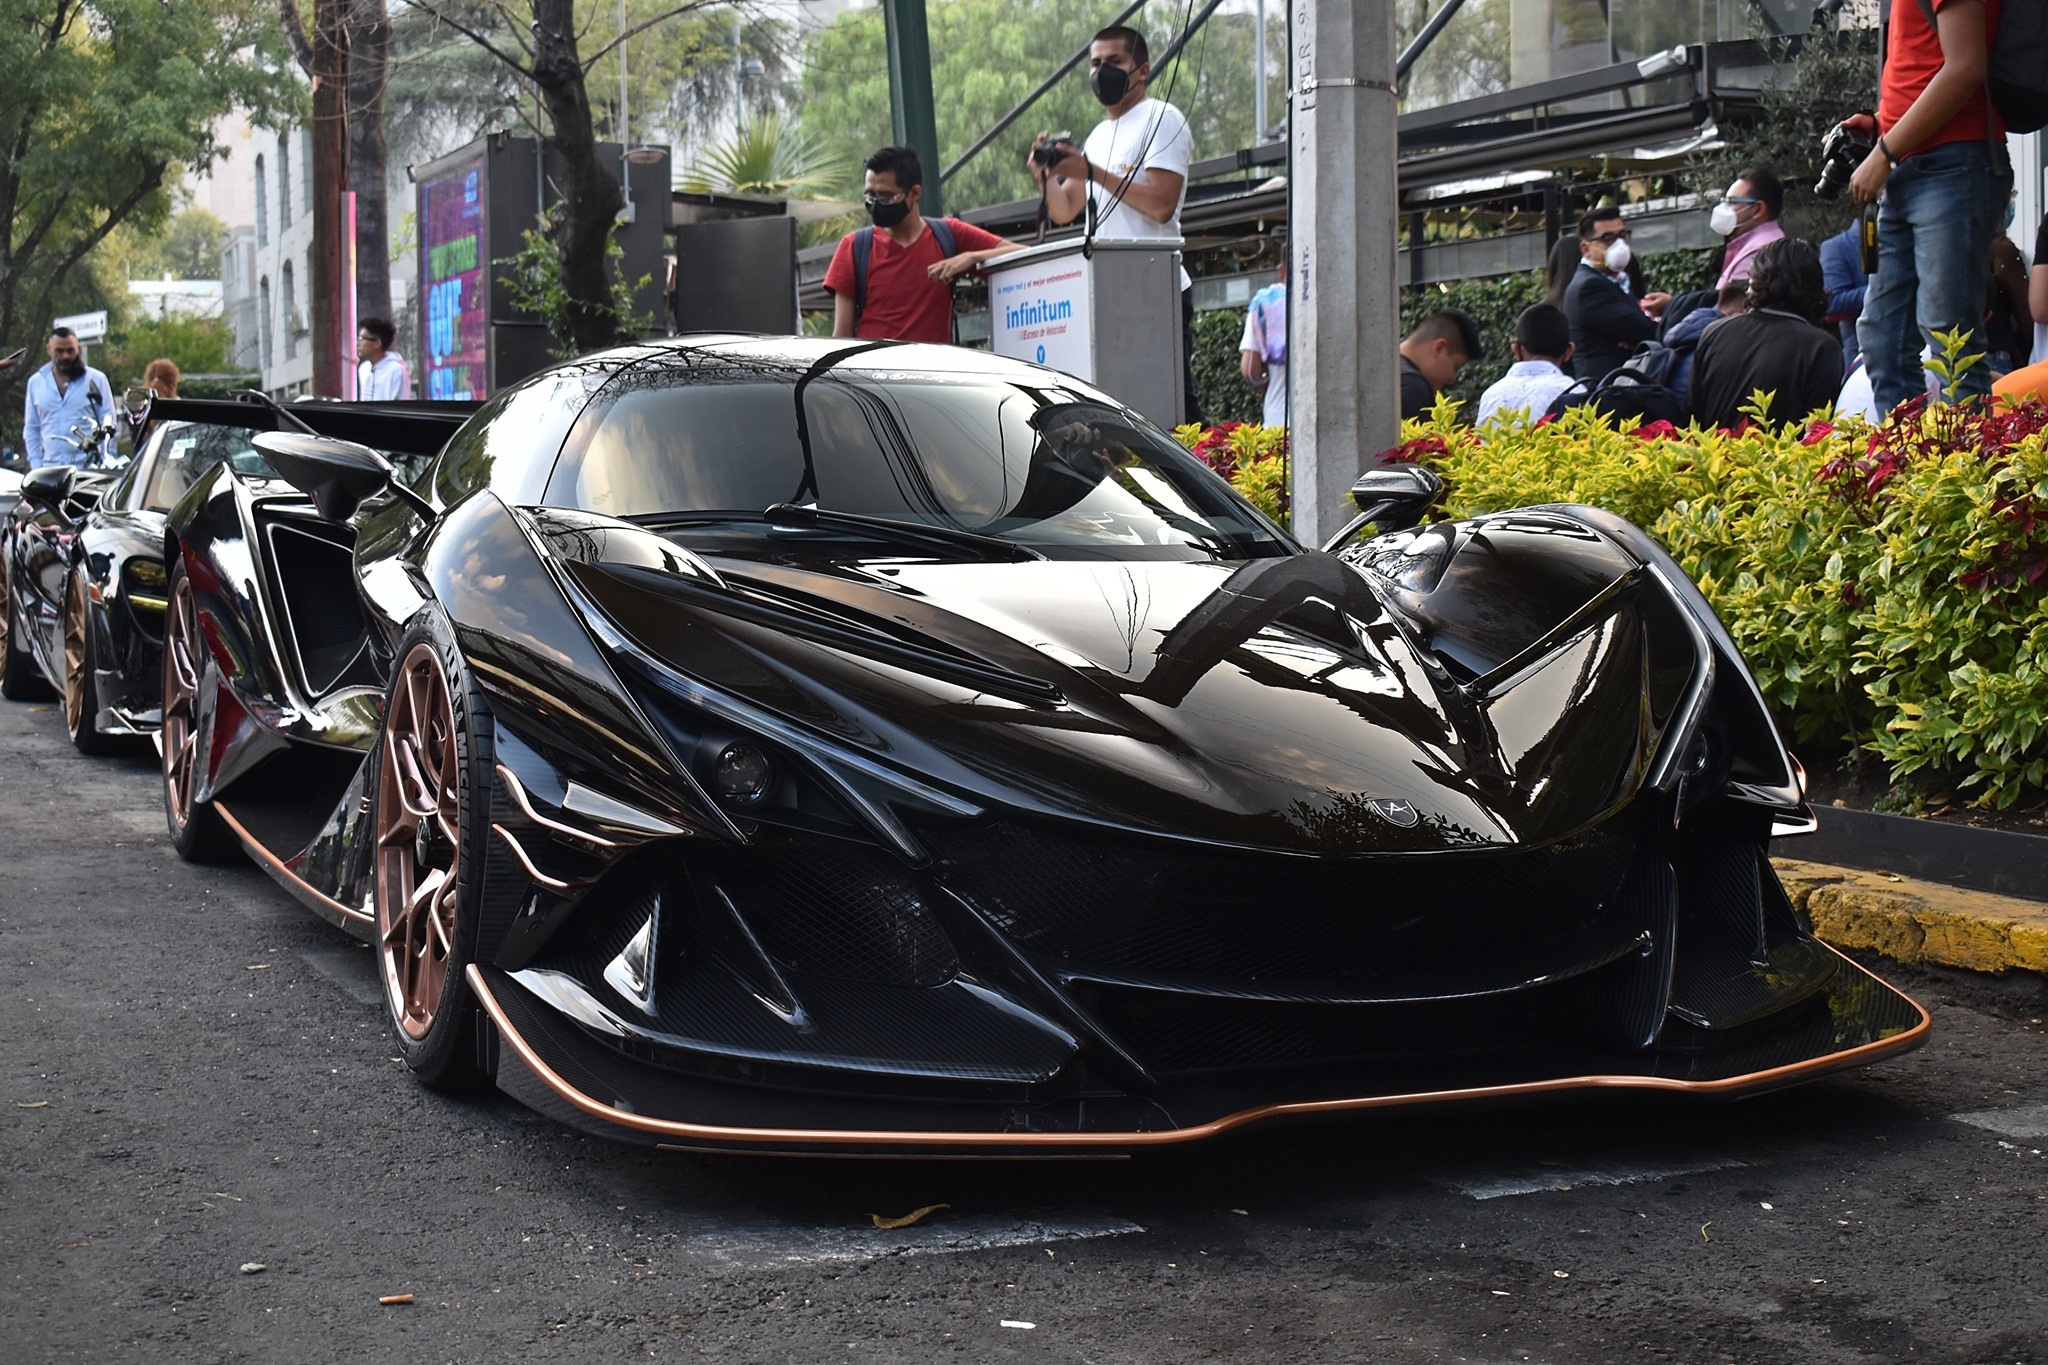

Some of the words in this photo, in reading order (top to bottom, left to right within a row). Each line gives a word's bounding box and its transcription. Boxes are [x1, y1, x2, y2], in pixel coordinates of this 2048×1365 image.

[1003, 284, 1014, 293] mejor
[1015, 282, 1023, 290] red
[1033, 278, 1045, 288] mejor
[1046, 270, 1082, 283] entretenimiento
[1006, 299, 1071, 329] infinitum
[457, 732, 471, 883] MICHELIN
